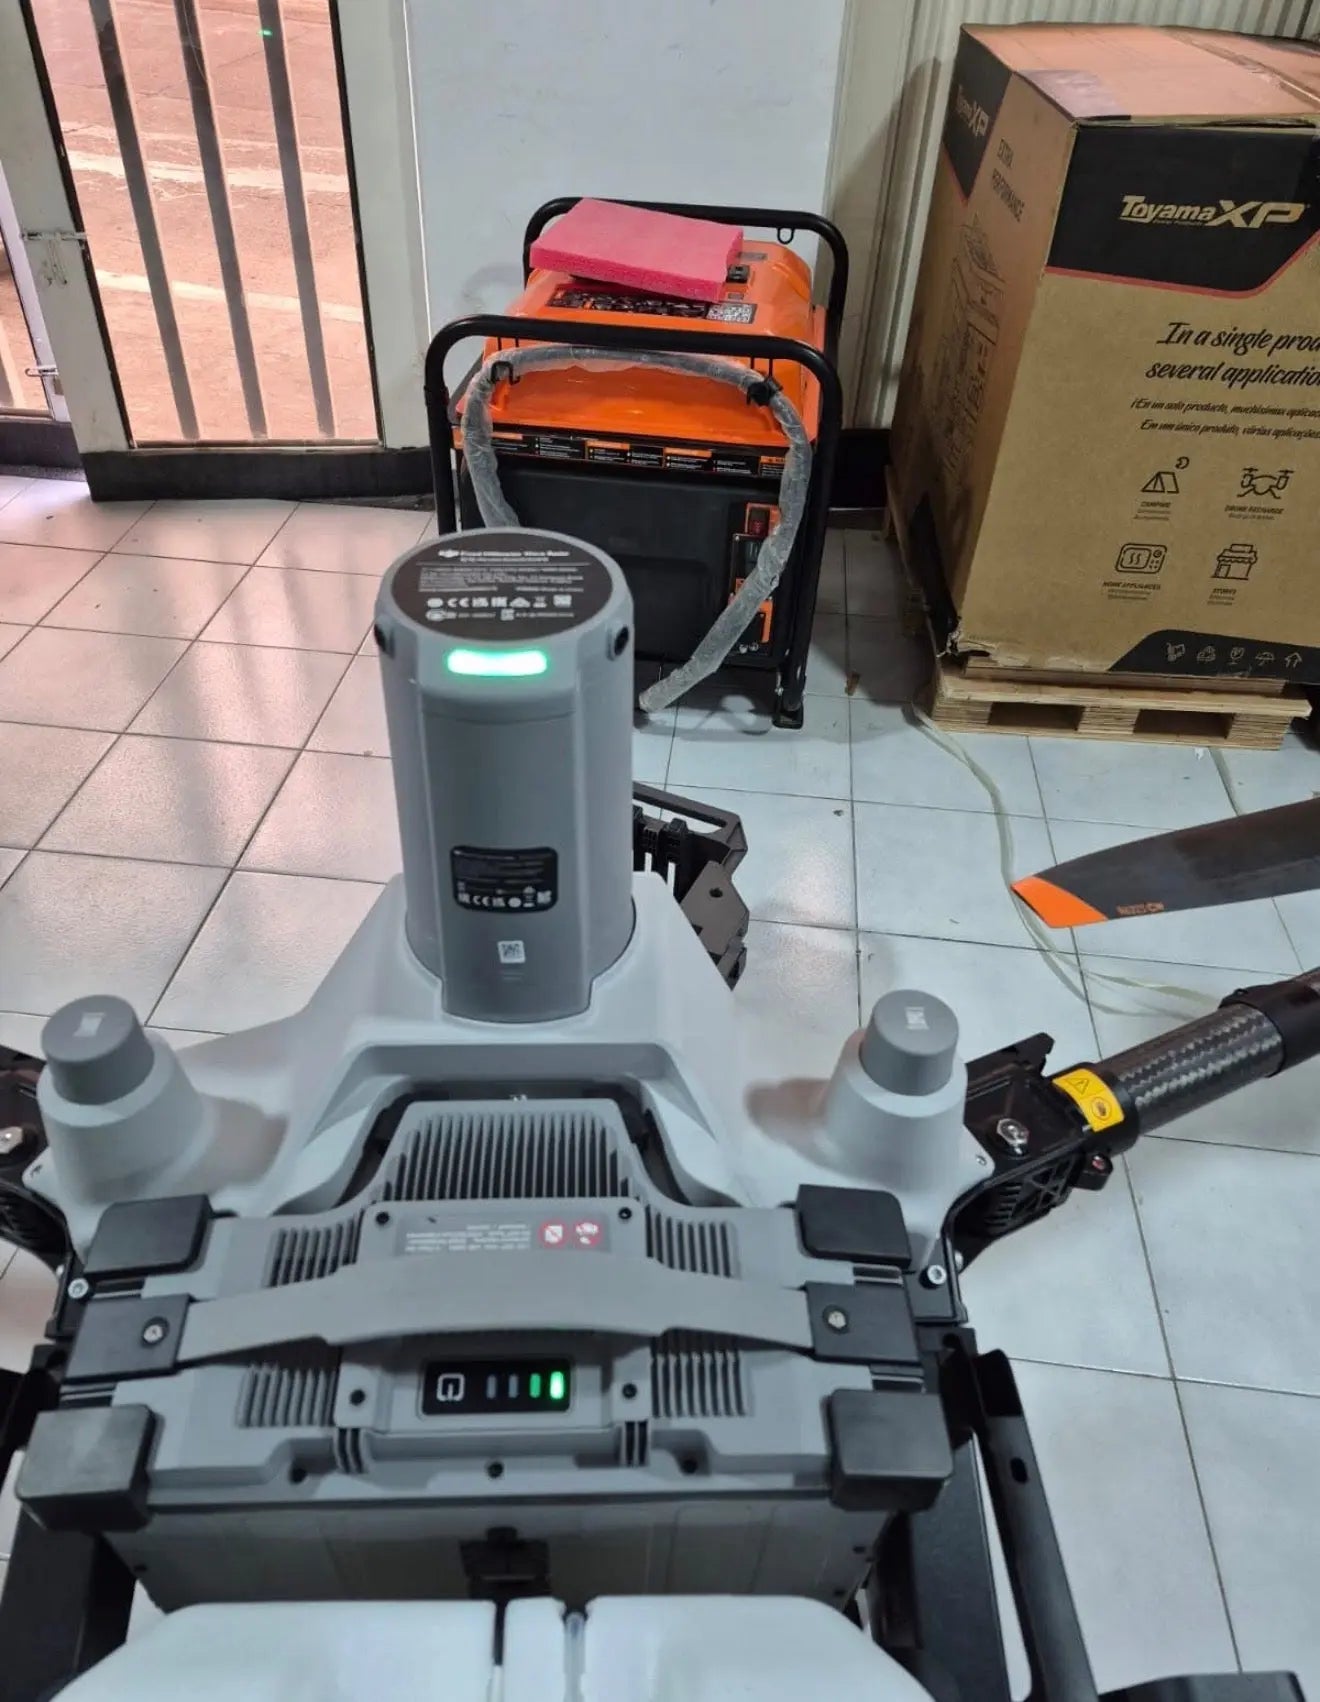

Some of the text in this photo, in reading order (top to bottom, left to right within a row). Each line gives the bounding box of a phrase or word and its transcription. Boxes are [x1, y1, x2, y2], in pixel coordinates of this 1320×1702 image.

[1156, 322, 1194, 345] In
[1193, 330, 1212, 346] a
[1211, 327, 1273, 356] single
[1145, 362, 1225, 381] several
